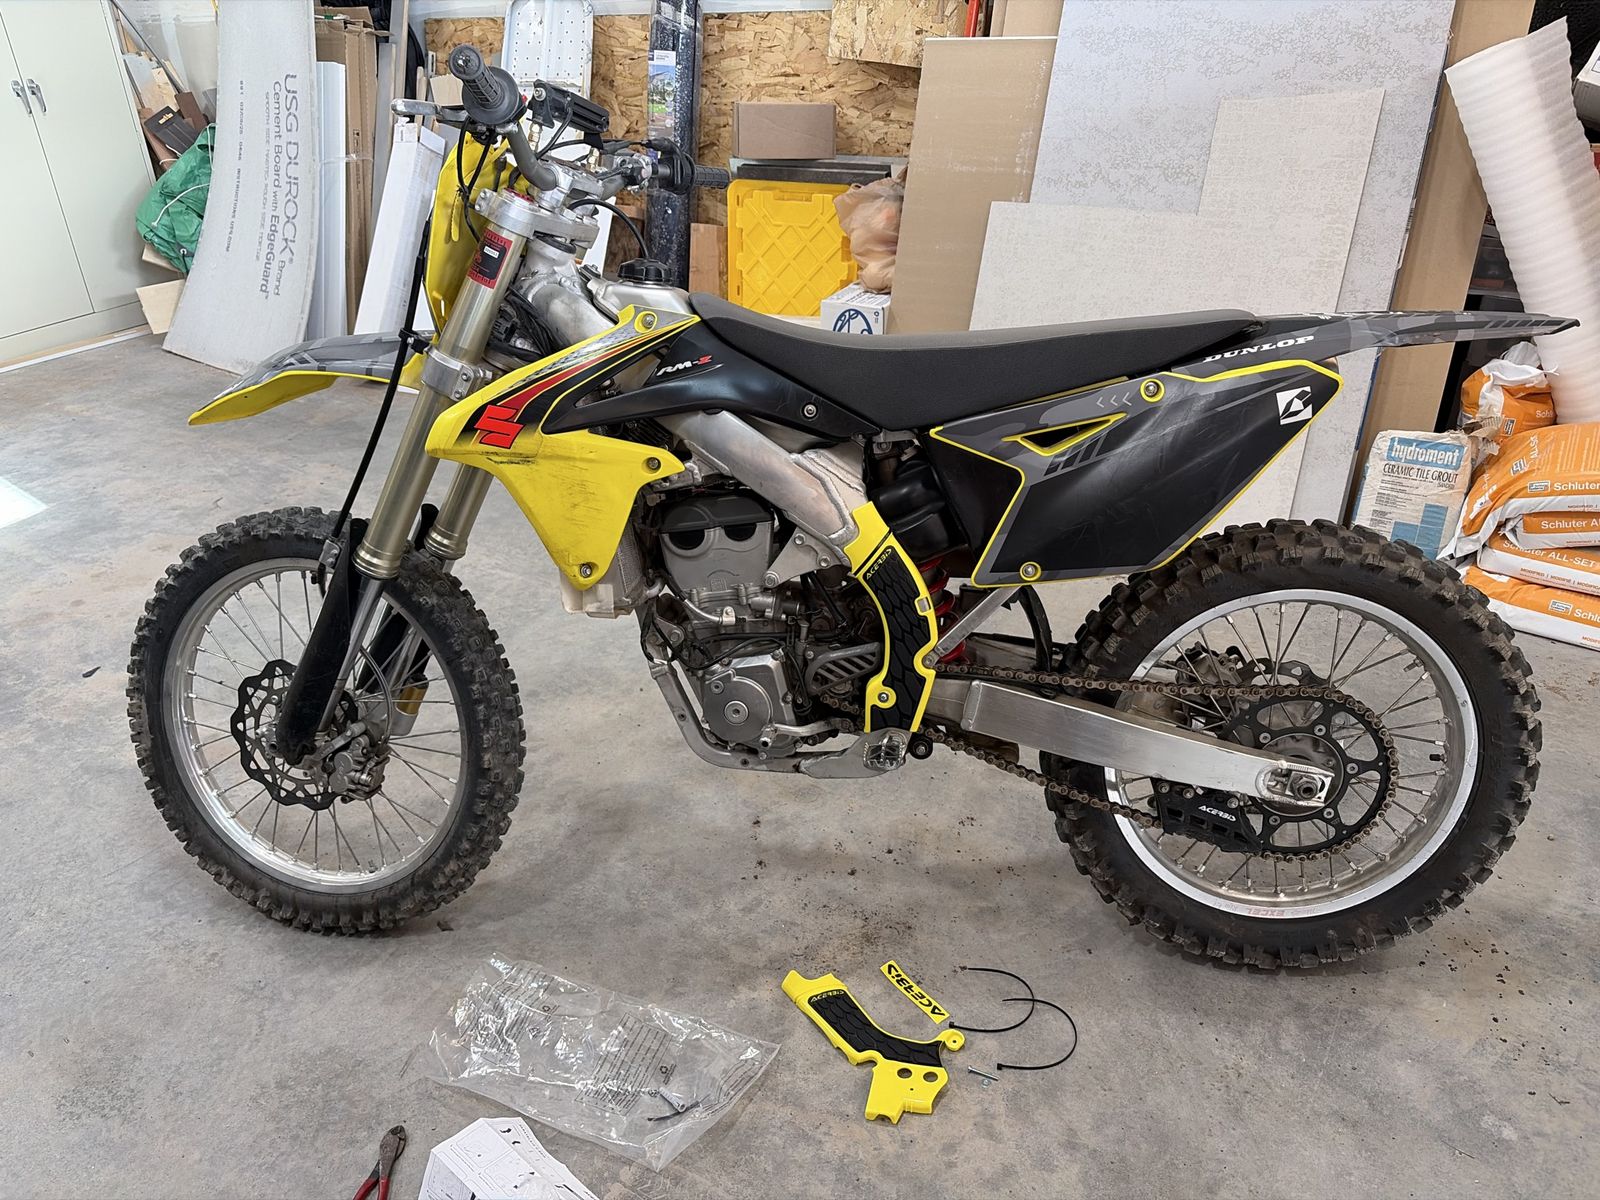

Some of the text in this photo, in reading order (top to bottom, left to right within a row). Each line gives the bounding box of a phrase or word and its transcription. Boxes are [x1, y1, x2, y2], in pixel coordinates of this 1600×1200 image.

[273, 81, 282, 139] Cement
[284, 74, 299, 133] USG
[273, 145, 282, 188] Board
[271, 190, 279, 212] with
[273, 260, 286, 296] Brand
[1203, 335, 1315, 363] DUNLOP
[656, 355, 712, 377] RM-Z
[1391, 438, 1460, 466] hydroment
[1383, 463, 1415, 478] CERAMIC
[1415, 467, 1431, 480] TILE
[1431, 470, 1459, 484] GROUT
[1553, 481, 1600, 491] Schluter
[1541, 519, 1588, 529] Schluter
[866, 548, 892, 580] ACERBIS
[1547, 551, 1596, 568] ALL-SET
[1198, 805, 1236, 822] ACERBIS
[1247, 907, 1286, 918] EXCEL
[810, 990, 845, 1003] ACERBIS
[887, 964, 946, 1017] ACERBIS
